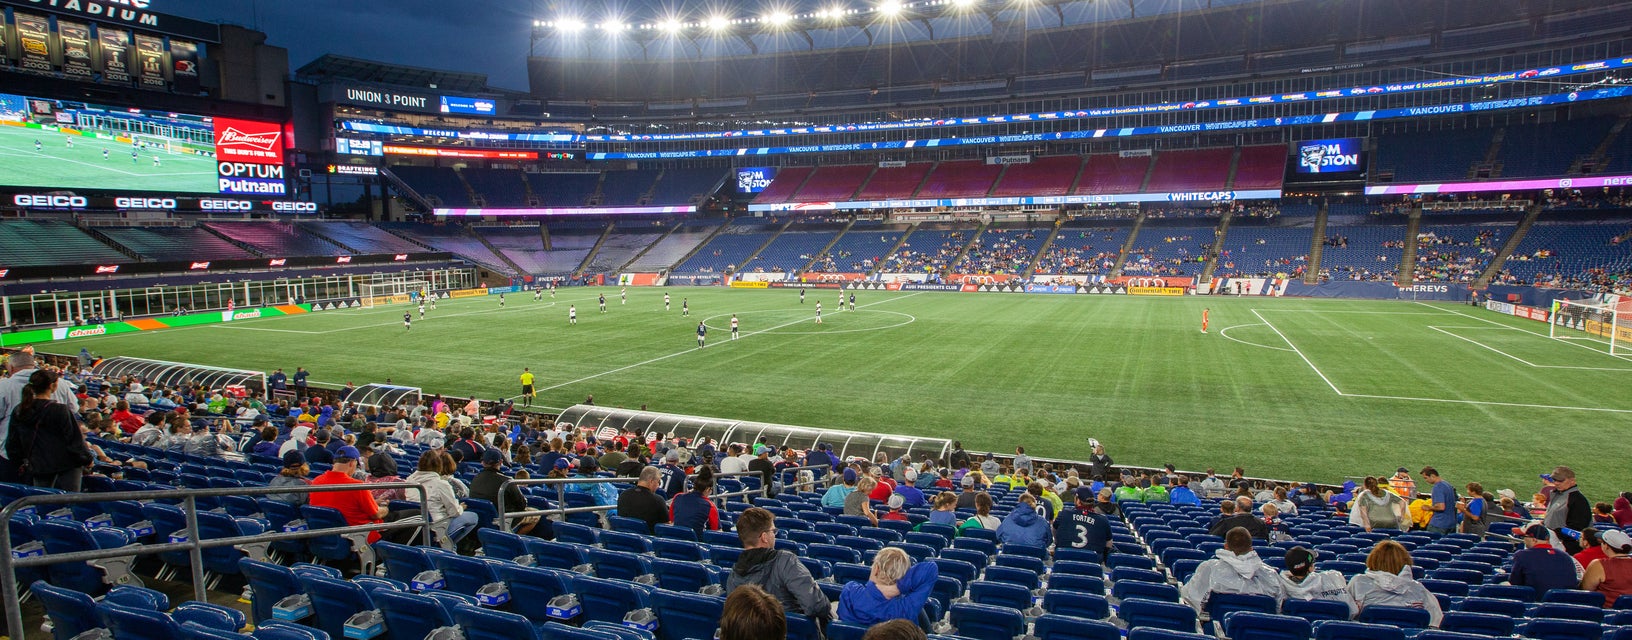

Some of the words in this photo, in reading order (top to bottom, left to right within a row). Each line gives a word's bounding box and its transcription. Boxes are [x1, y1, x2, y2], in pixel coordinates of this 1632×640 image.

[30, 0, 158, 26] TADIUM
[24, 62, 50, 70] 2003
[66, 67, 91, 76] 2004
[107, 73, 128, 81] 2014
[1422, 80, 1454, 88] locations
[1465, 76, 1482, 85] New
[1484, 73, 1516, 84] England
[347, 89, 382, 103] UNION
[393, 94, 426, 107] POINT
[1410, 104, 1463, 115] VANCOUVER
[1470, 98, 1528, 110] WHITECAPS
[1529, 97, 1543, 105] FC
[1160, 124, 1200, 133] VANCOUVER
[1205, 120, 1246, 129] WHITECAPS
[222, 131, 275, 144] Budweiser
[1300, 154, 1358, 167] BSTON
[219, 162, 284, 179] OPTUM
[219, 178, 285, 193] Putnam
[739, 179, 774, 188] BSTON
[14, 194, 87, 207] GEICO
[115, 197, 176, 209] GEICO
[1171, 192, 1232, 201] WHITECAPS
[200, 200, 252, 210] GEICO
[272, 202, 317, 211] GEICO
[1072, 525, 1088, 548] 3
